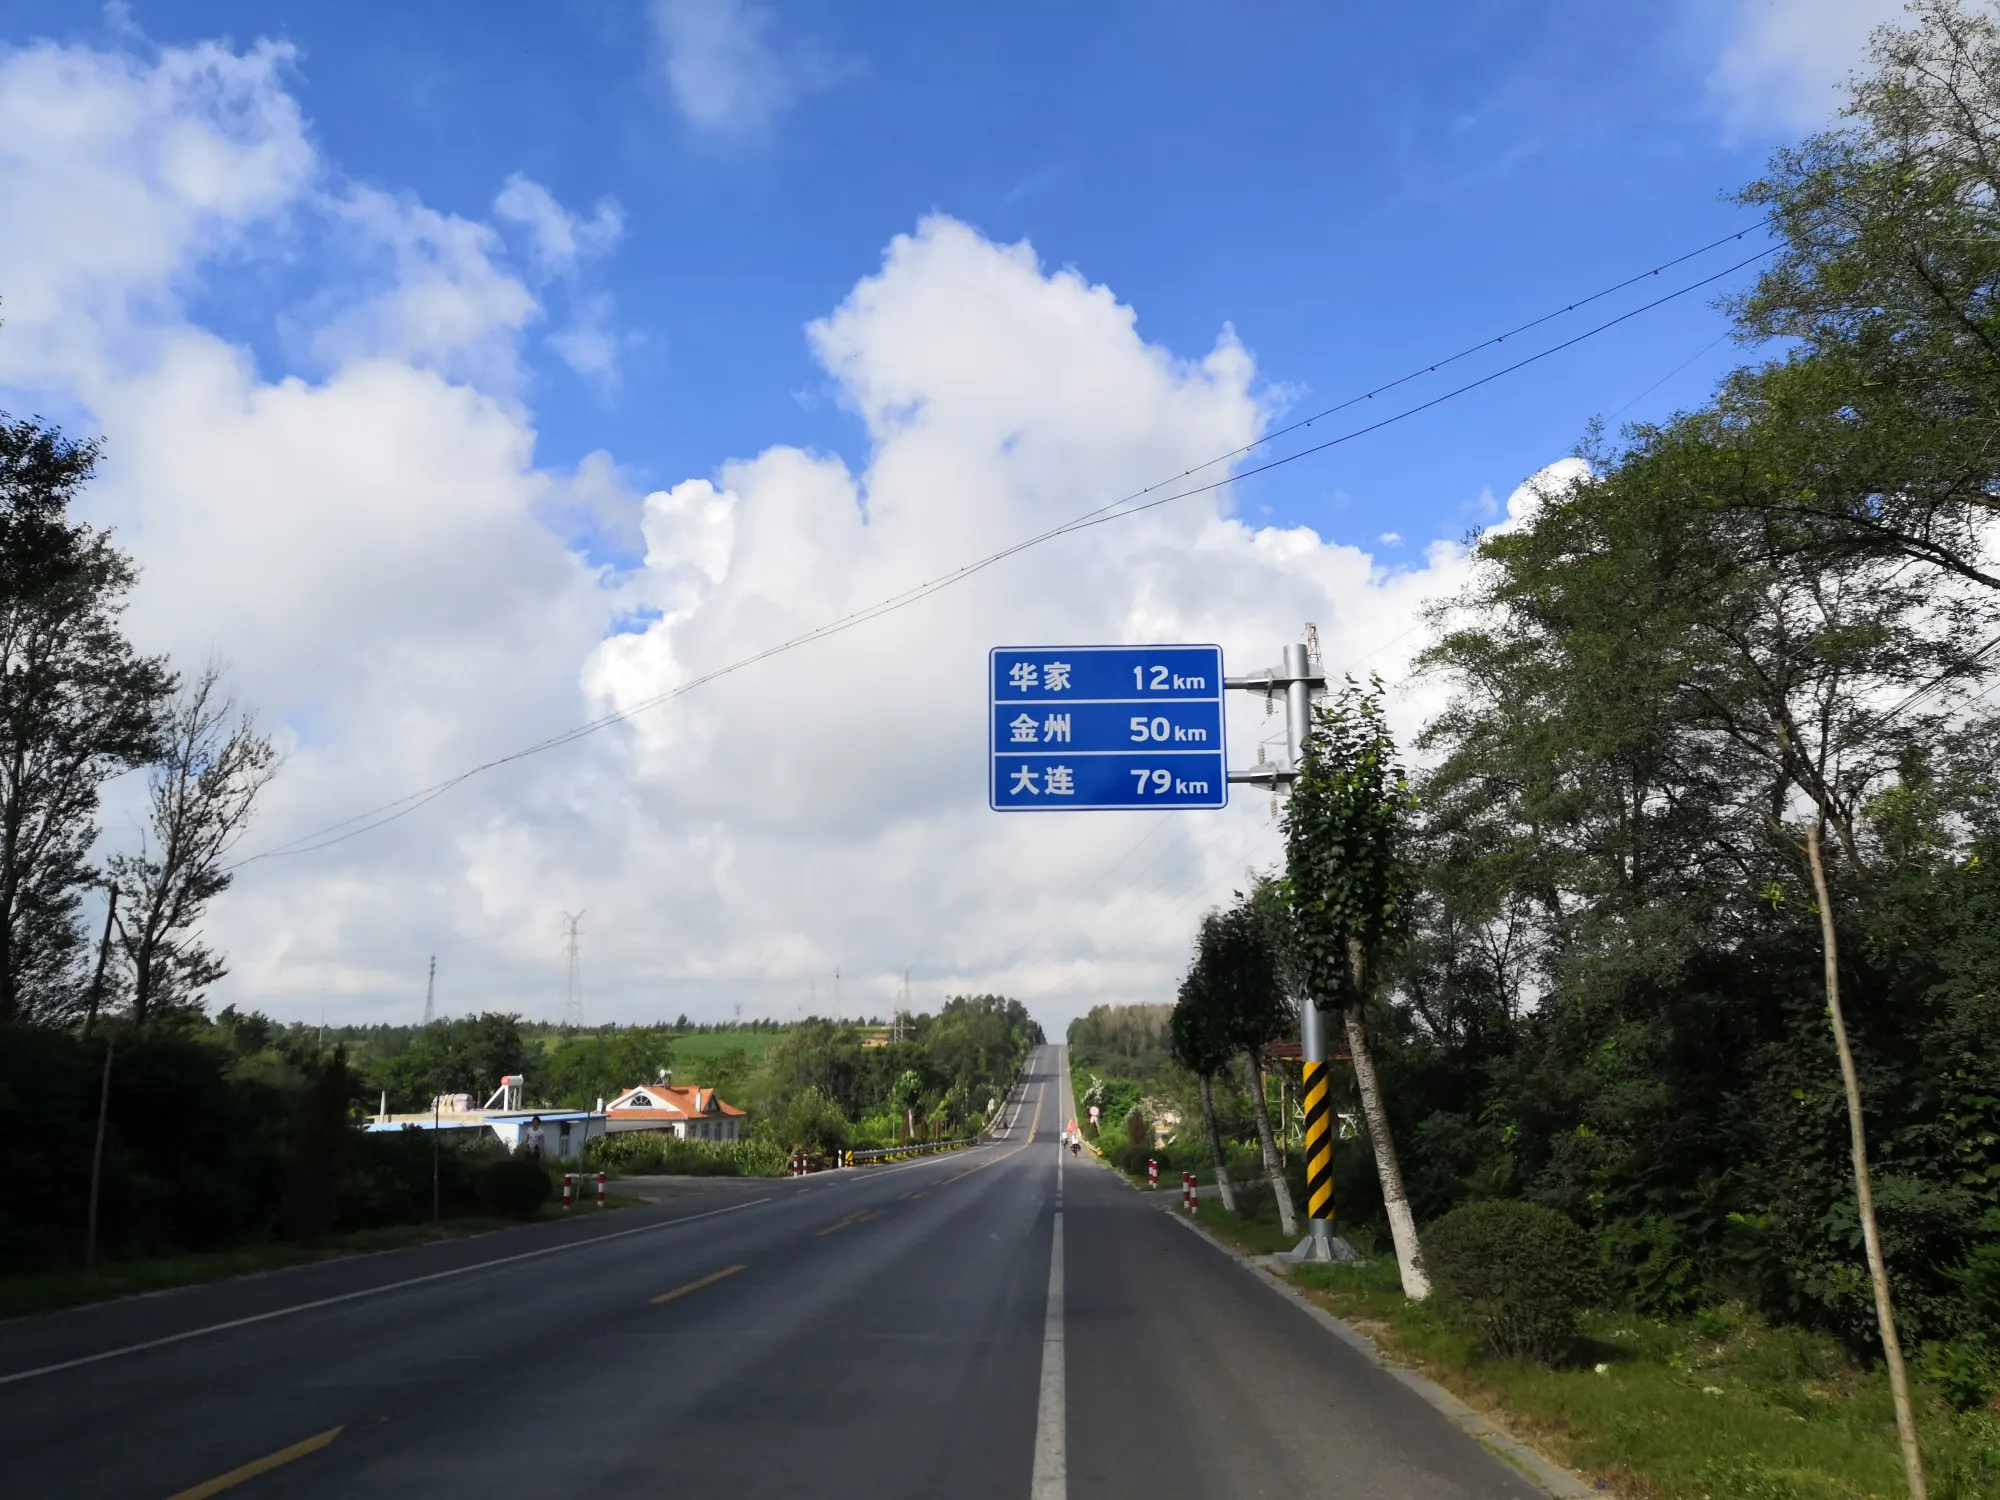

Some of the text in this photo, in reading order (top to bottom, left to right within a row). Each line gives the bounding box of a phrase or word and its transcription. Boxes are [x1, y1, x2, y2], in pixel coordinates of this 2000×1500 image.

[1009, 661, 1206, 692] 华家 12km
[1009, 713, 1207, 743] 金州 50km
[1010, 765, 1209, 795] 大连 79km
